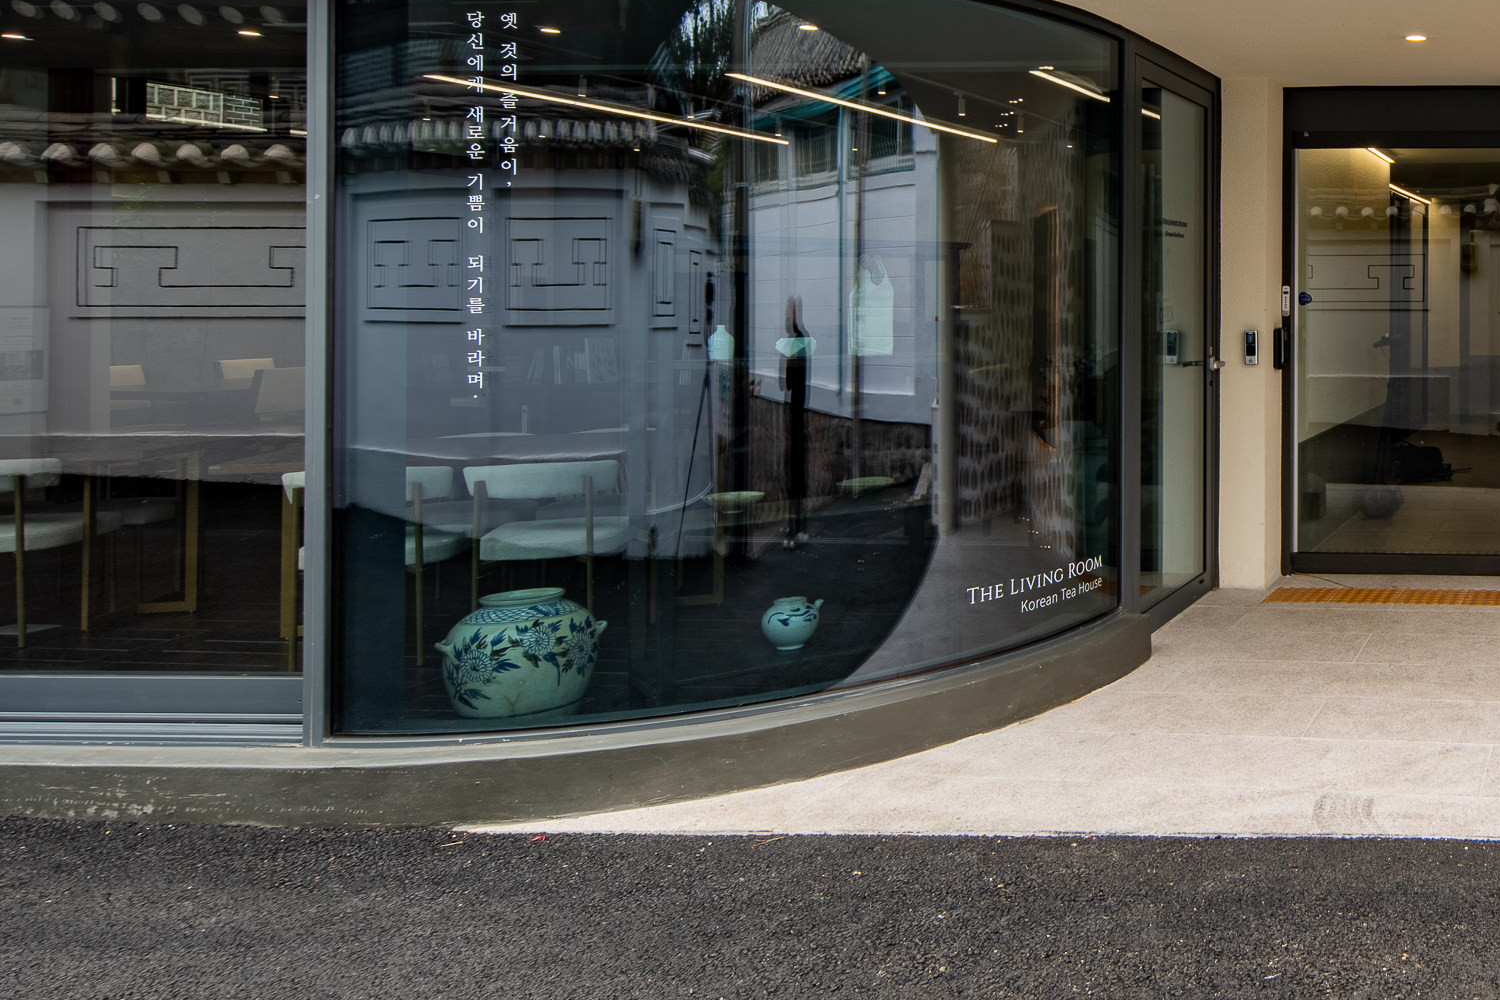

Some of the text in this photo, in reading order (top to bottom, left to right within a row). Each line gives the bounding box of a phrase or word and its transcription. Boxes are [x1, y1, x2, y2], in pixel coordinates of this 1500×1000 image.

[500, 12, 518, 29] 옛
[500, 41, 518, 81] 것의
[466, 10, 485, 399] 당신에게 새로운 기쁨이 되기를 바라며.
[966, 554, 1103, 605] THE LIVING ROOM
[1020, 577, 1103, 613] Korean Tea House
